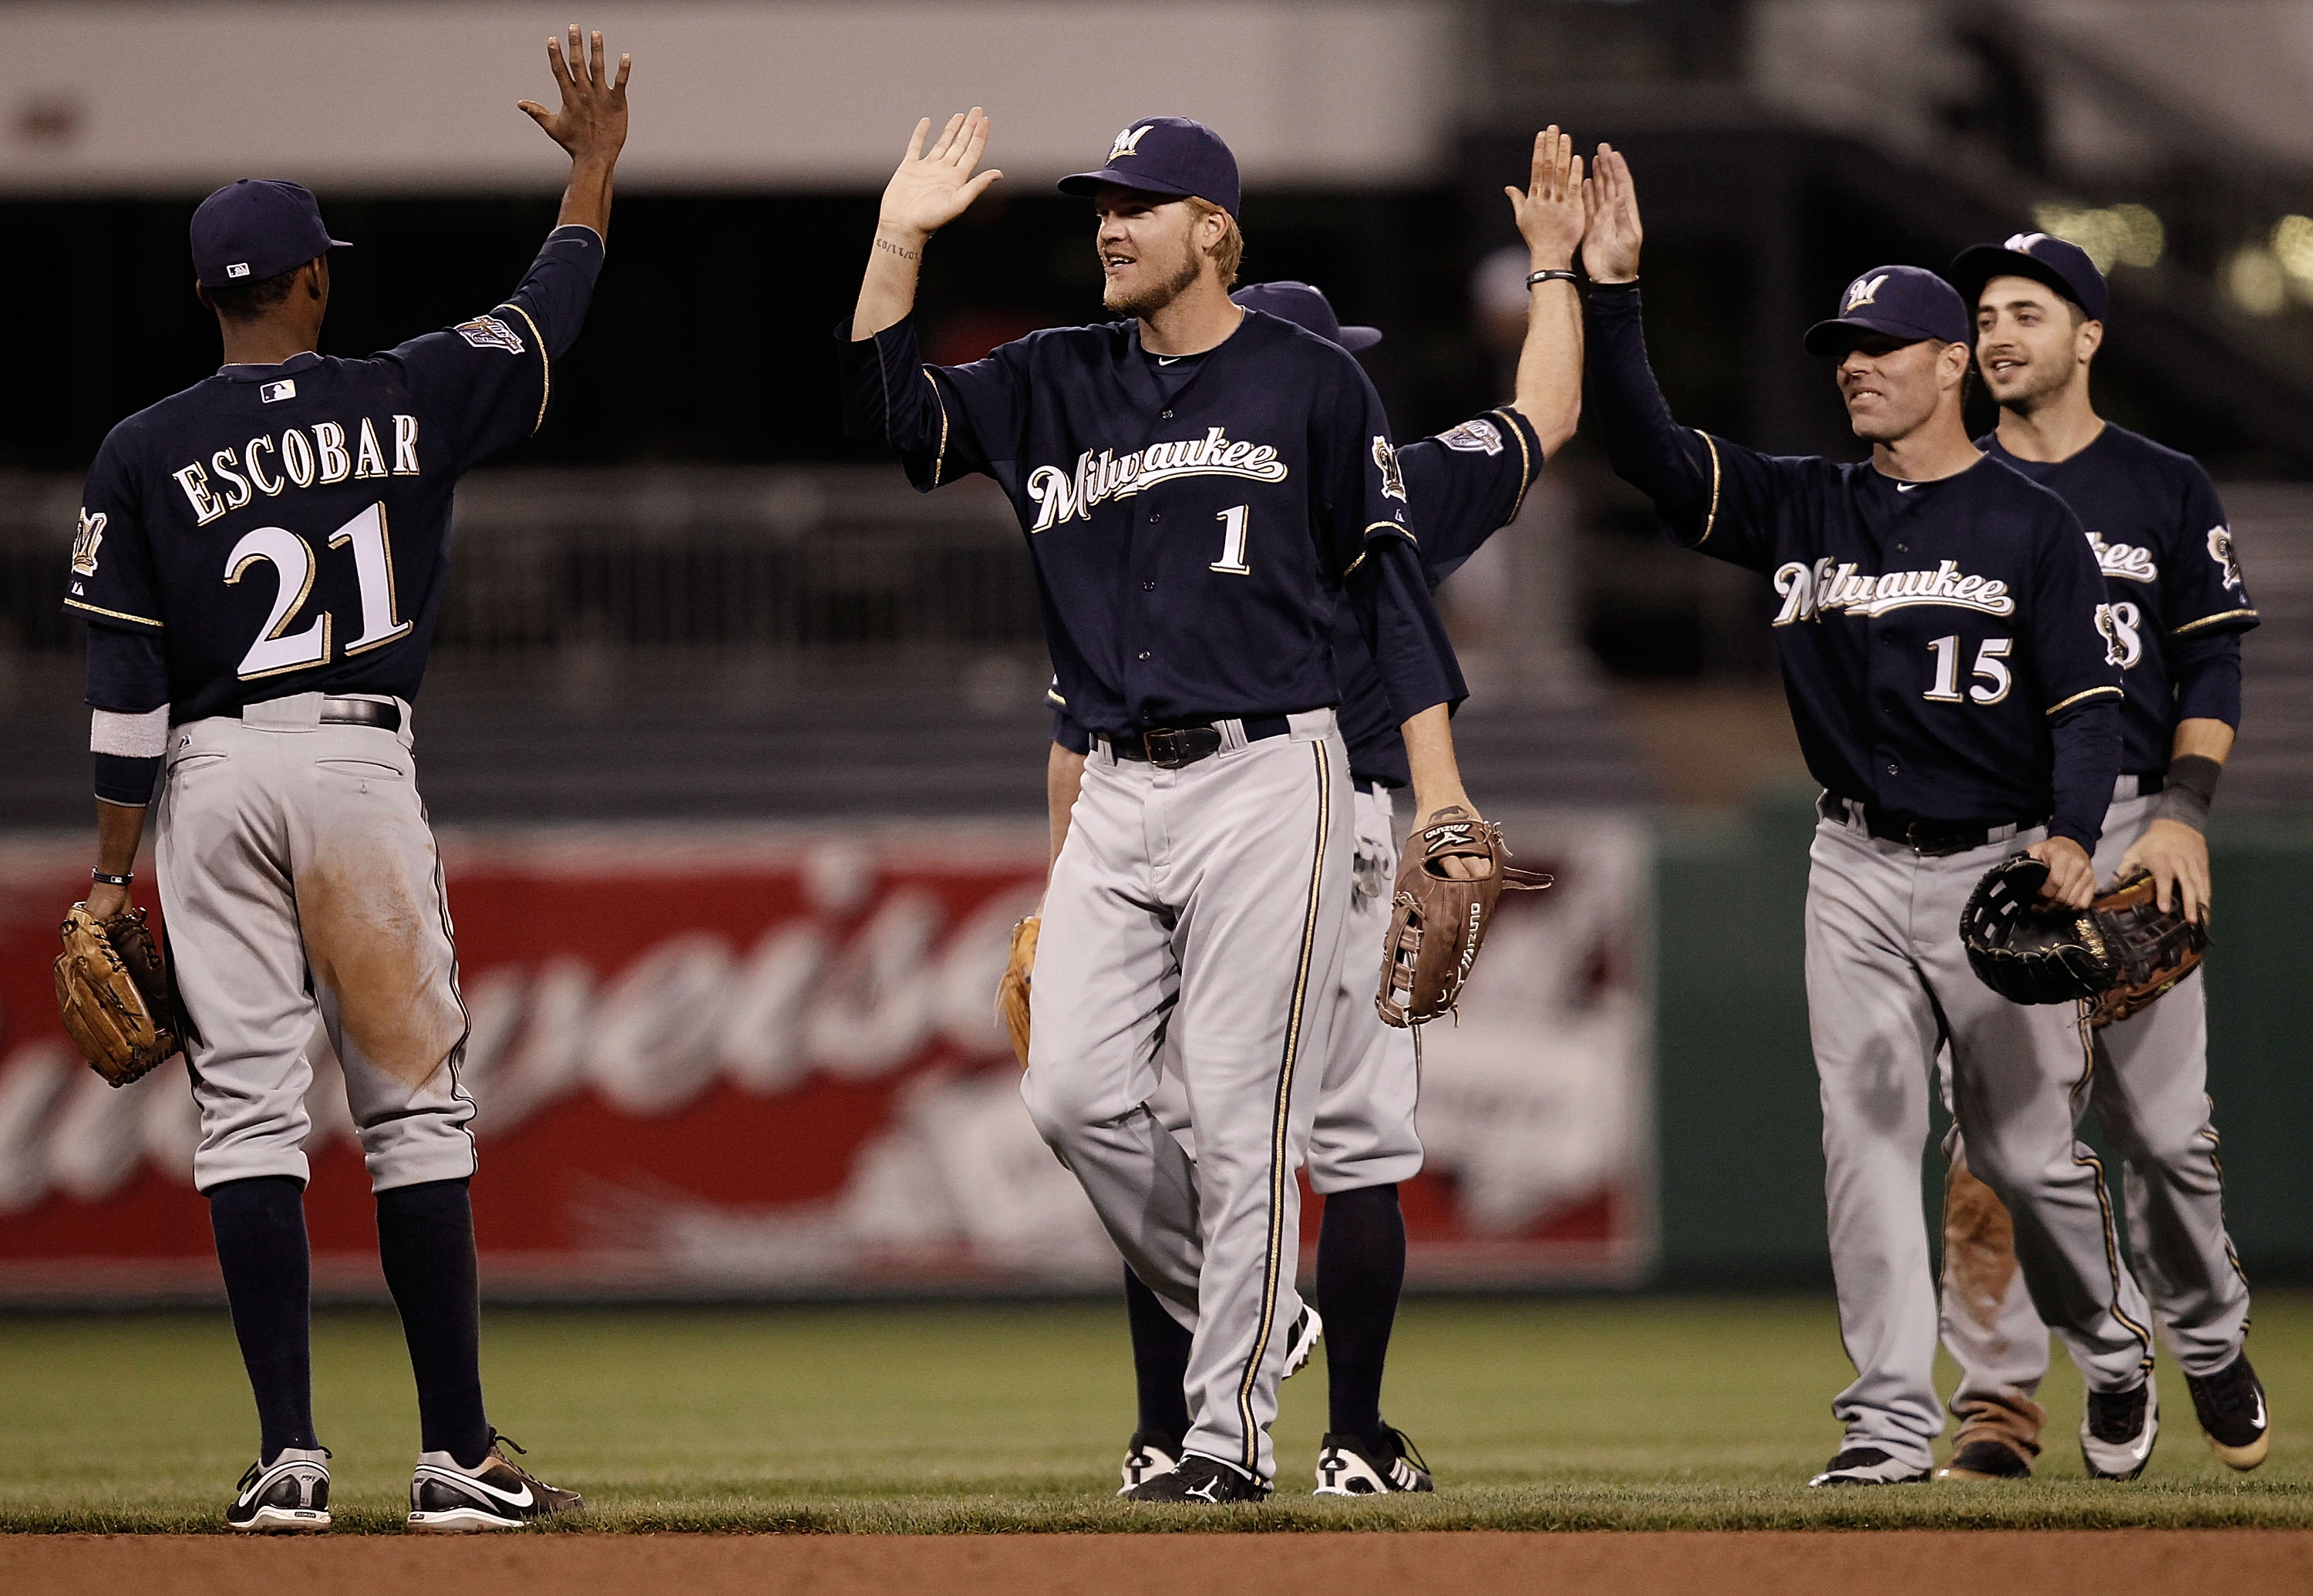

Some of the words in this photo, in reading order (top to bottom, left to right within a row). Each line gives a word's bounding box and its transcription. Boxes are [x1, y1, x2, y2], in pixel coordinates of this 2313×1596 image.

[1106, 125, 1154, 165] M
[1843, 274, 1889, 315] M
[173, 414, 420, 527] ESCOBAR
[1027, 426, 1288, 534] Milwaukee
[1209, 503, 1251, 575] 1
[223, 500, 414, 682] 21
[1772, 556, 2016, 628] Milwaukee
[1923, 635, 2014, 705] 15
